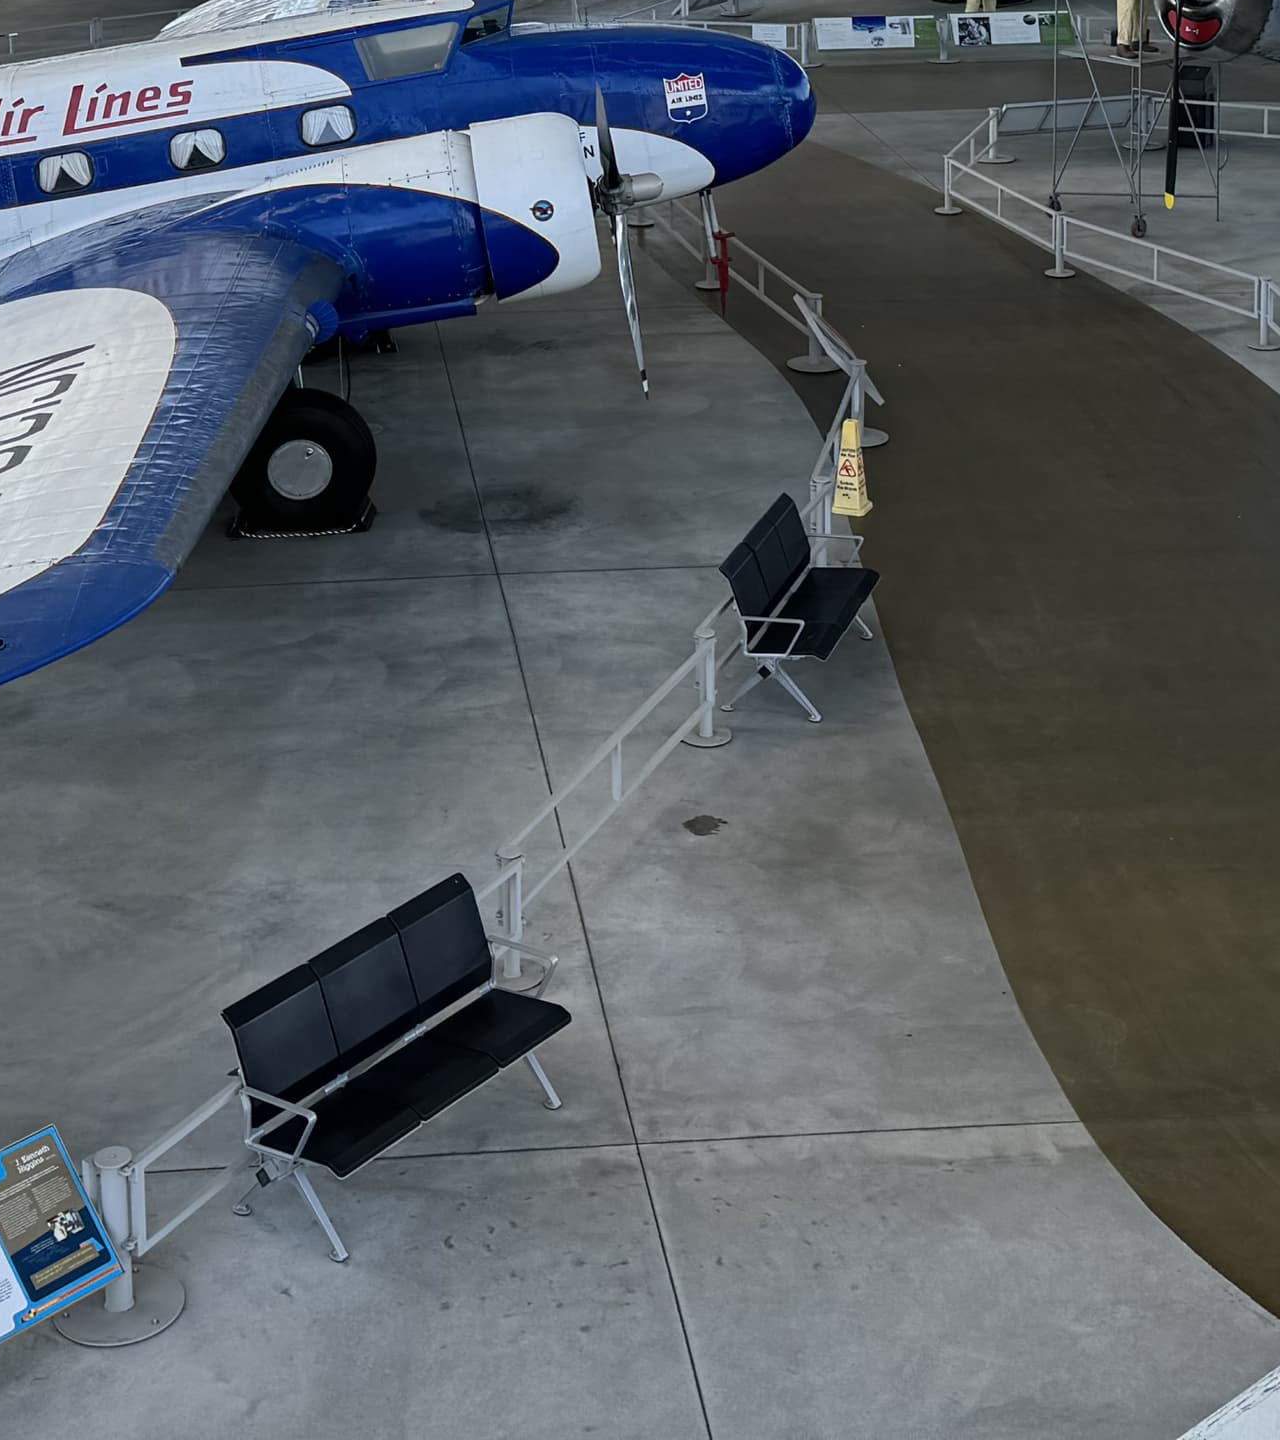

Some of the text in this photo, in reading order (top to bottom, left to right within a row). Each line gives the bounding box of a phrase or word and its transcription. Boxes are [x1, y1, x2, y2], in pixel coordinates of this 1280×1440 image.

[667, 77, 703, 94] UNITED
[62, 79, 195, 137] Lines
[671, 94, 703, 105] AIR LINES
